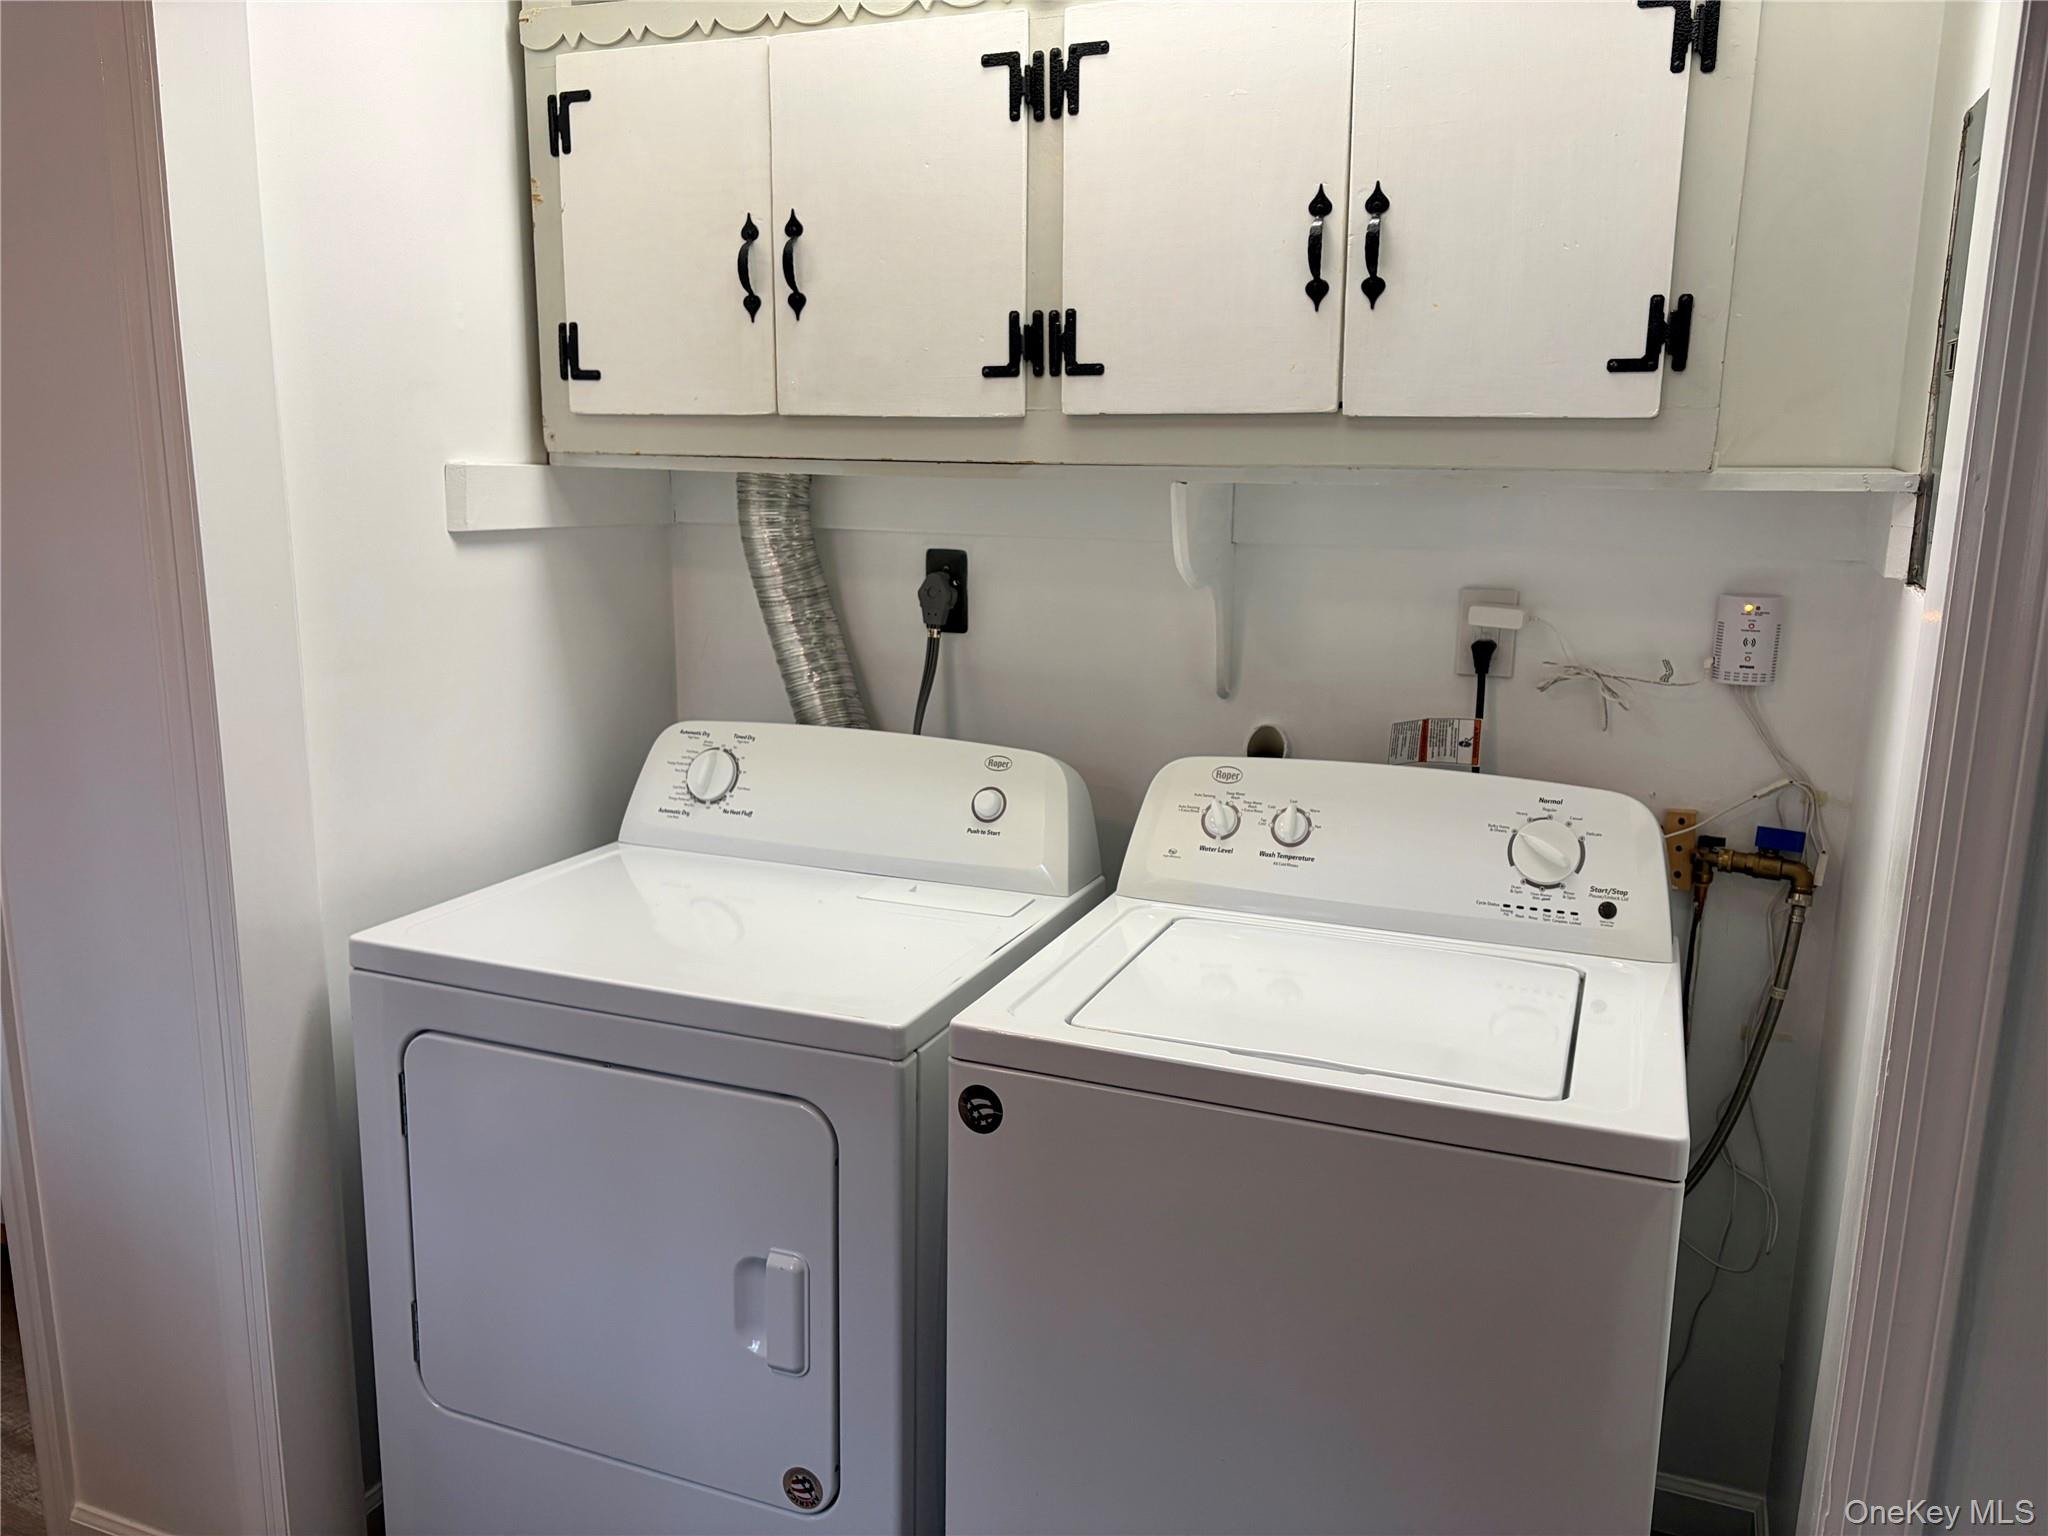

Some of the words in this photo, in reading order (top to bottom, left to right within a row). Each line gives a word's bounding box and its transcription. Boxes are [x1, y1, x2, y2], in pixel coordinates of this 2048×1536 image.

[988, 759, 1009, 768] Roper
[1216, 770, 1240, 781] Roper
[1539, 797, 1563, 805] Normal
[741, 810, 753, 818] Fluff
[1218, 846, 1233, 854] Level
[1277, 852, 1315, 862] Temperature
[1590, 886, 1628, 896] Start/Stop
